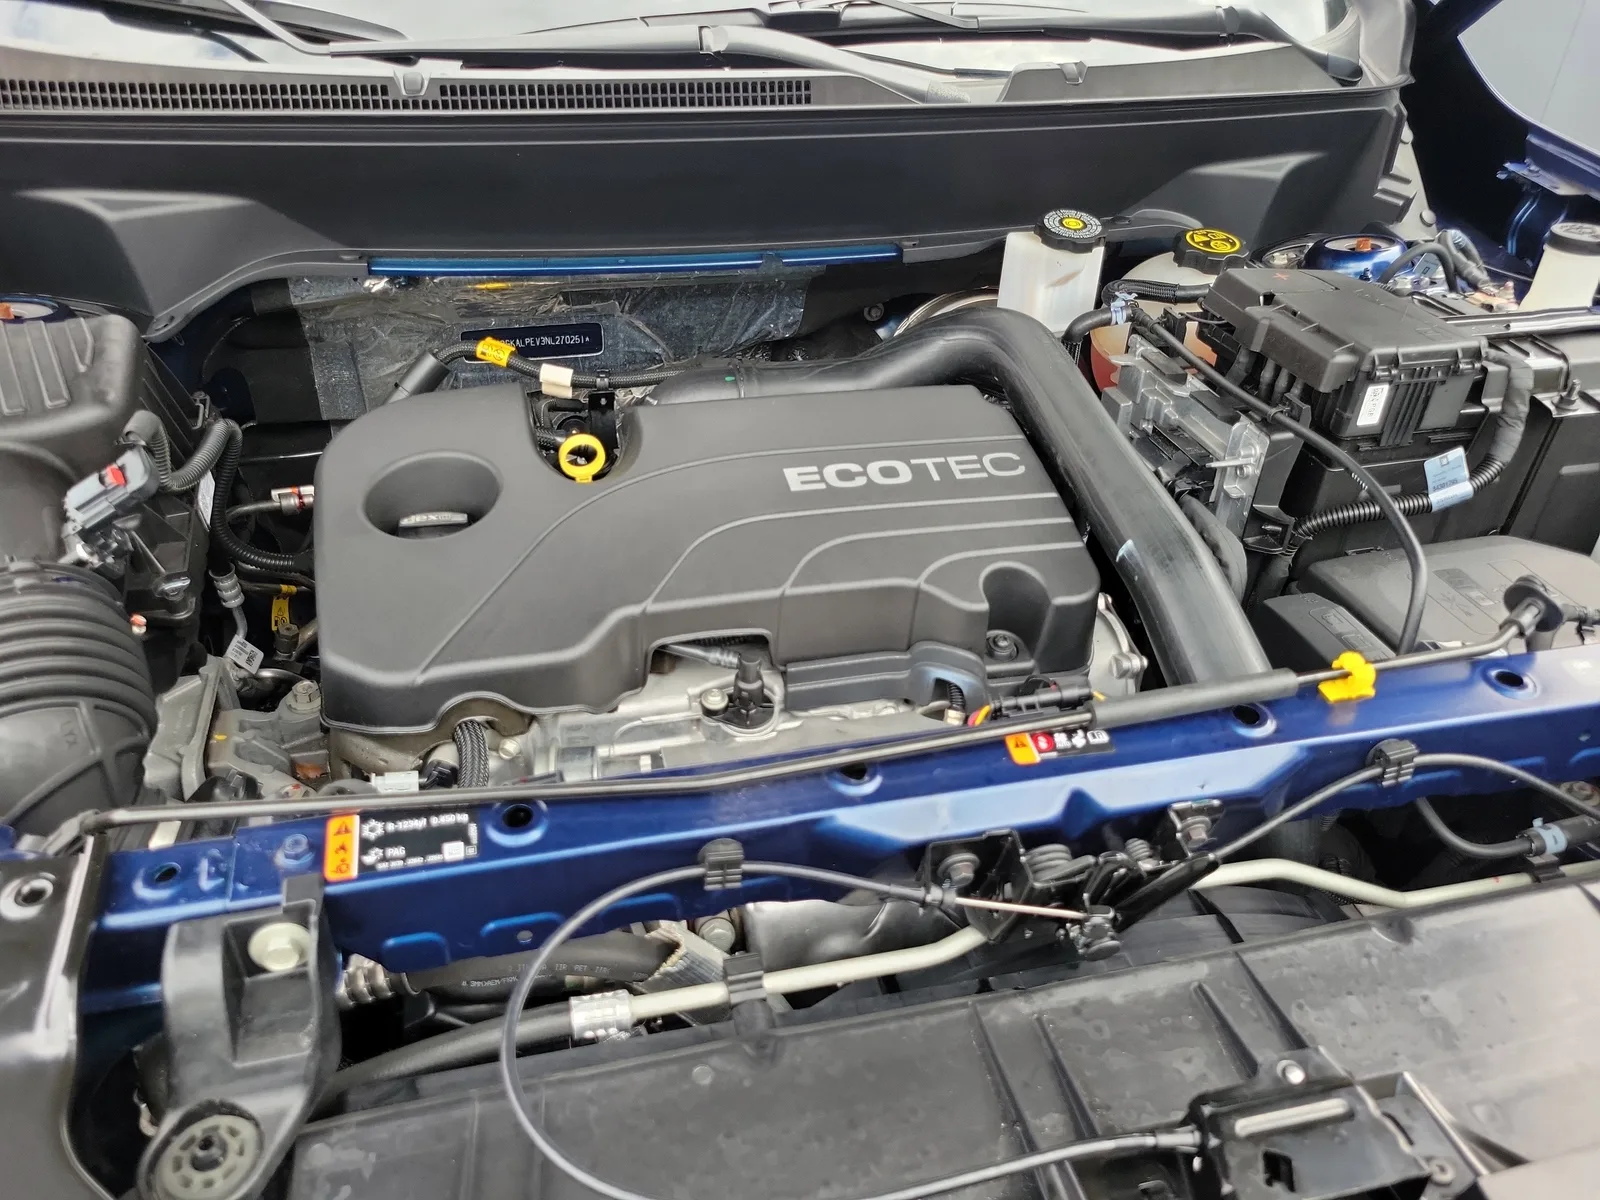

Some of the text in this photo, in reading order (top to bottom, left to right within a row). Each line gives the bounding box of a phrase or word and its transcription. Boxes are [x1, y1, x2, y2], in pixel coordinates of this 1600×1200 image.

[783, 452, 1026, 492] ECOTEC
[388, 813, 469, 831] R-1234yf 0.450 kg
[388, 846, 406, 857] PAG
